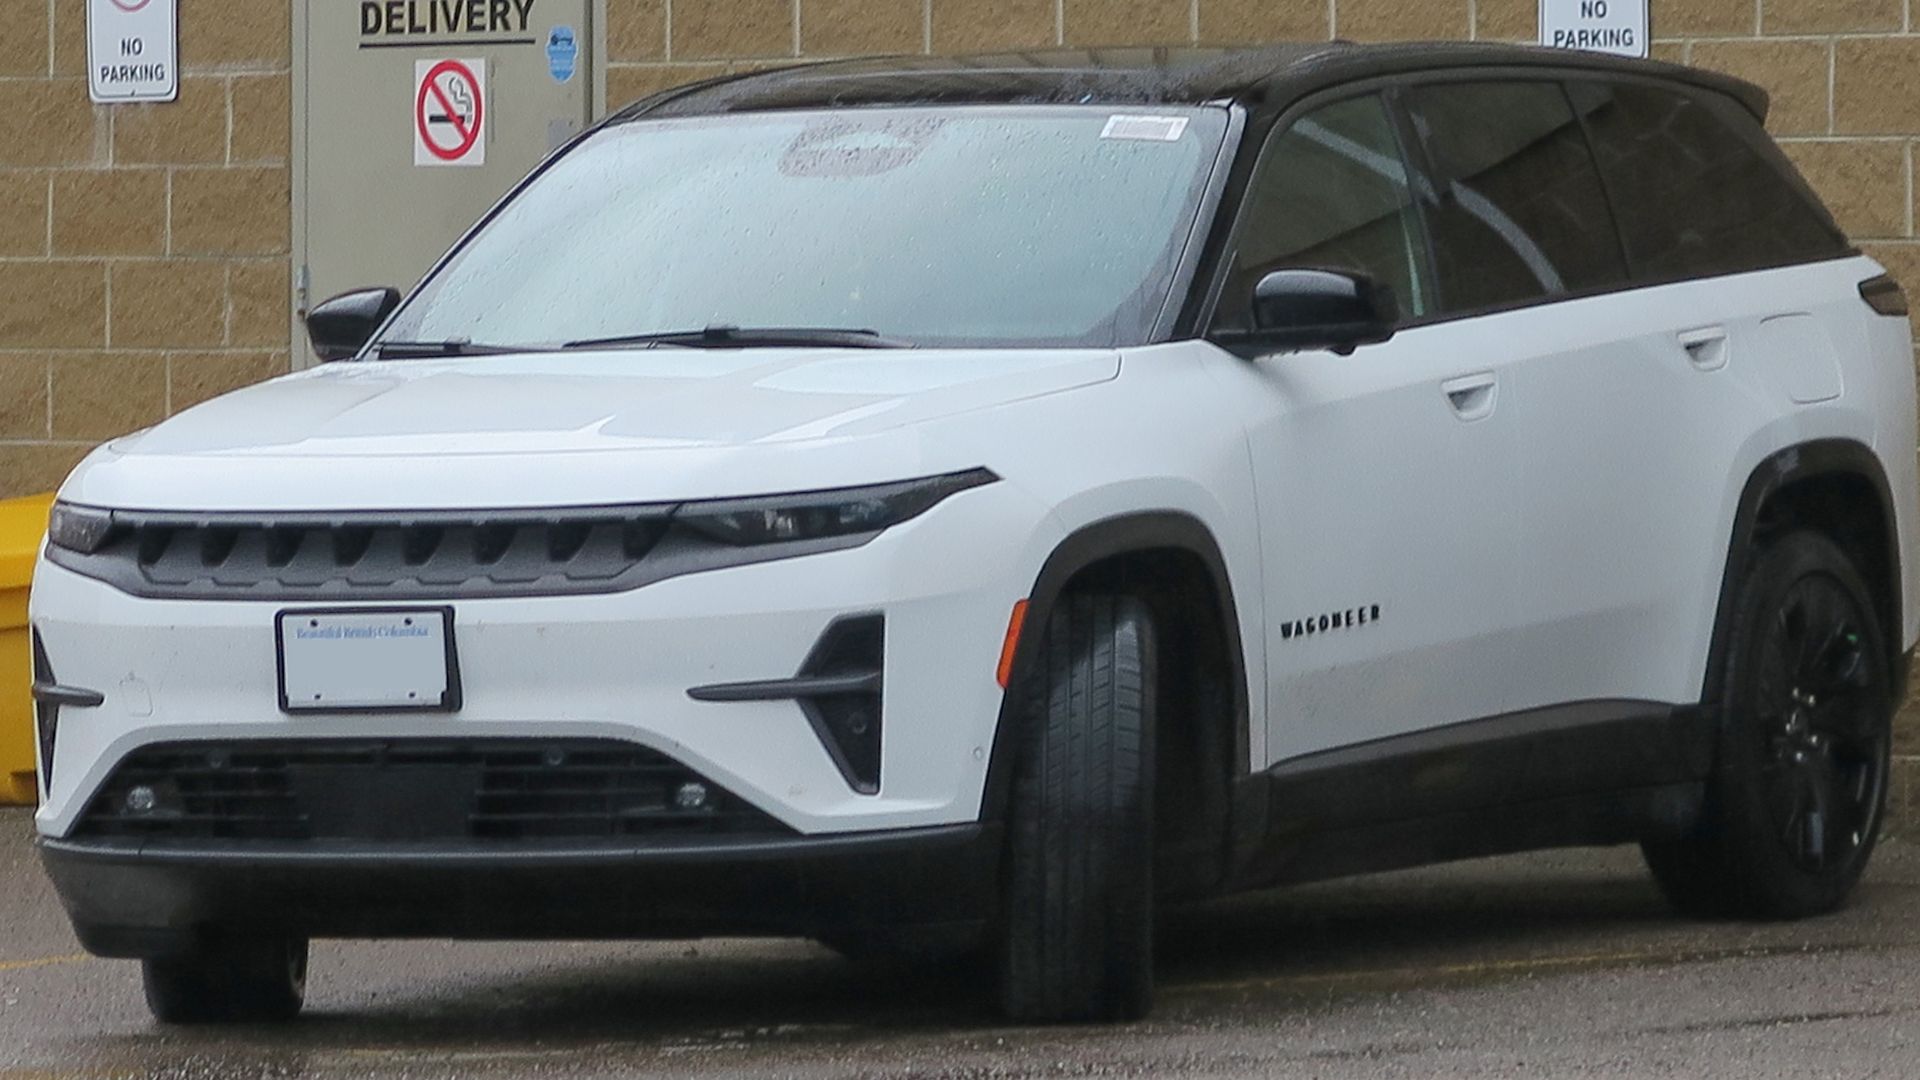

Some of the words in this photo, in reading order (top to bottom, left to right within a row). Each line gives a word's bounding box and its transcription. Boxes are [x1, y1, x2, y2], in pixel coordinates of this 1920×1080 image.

[361, 0, 534, 35] DELIVERY
[1581, 0, 1607, 18] NO
[121, 37, 142, 56] NO
[1554, 28, 1633, 48] PARKING
[100, 63, 165, 83] PARKING
[1281, 604, 1380, 639] WAGONEER
